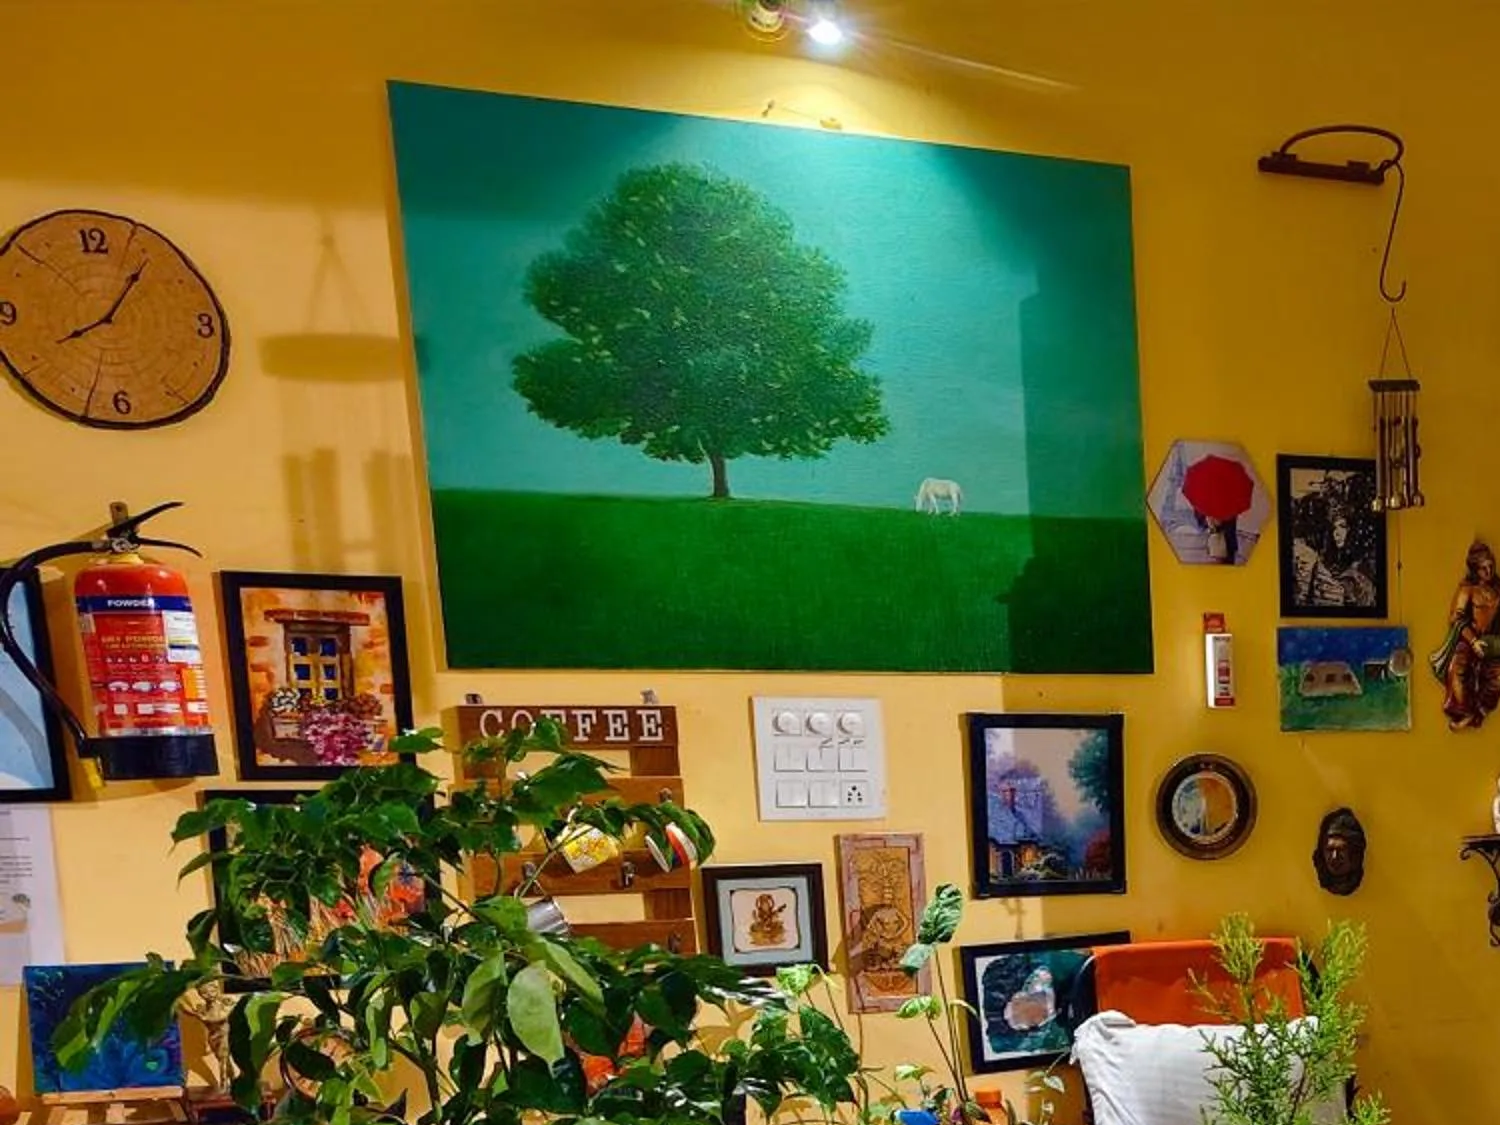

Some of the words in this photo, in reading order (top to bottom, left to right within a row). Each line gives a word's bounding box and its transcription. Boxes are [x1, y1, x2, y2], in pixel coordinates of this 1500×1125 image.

[80, 228, 109, 254] 12
[0, 301, 17, 325] 9
[198, 313, 214, 338] 3
[112, 390, 131, 414] 6
[480, 709, 664, 741] COFEE
